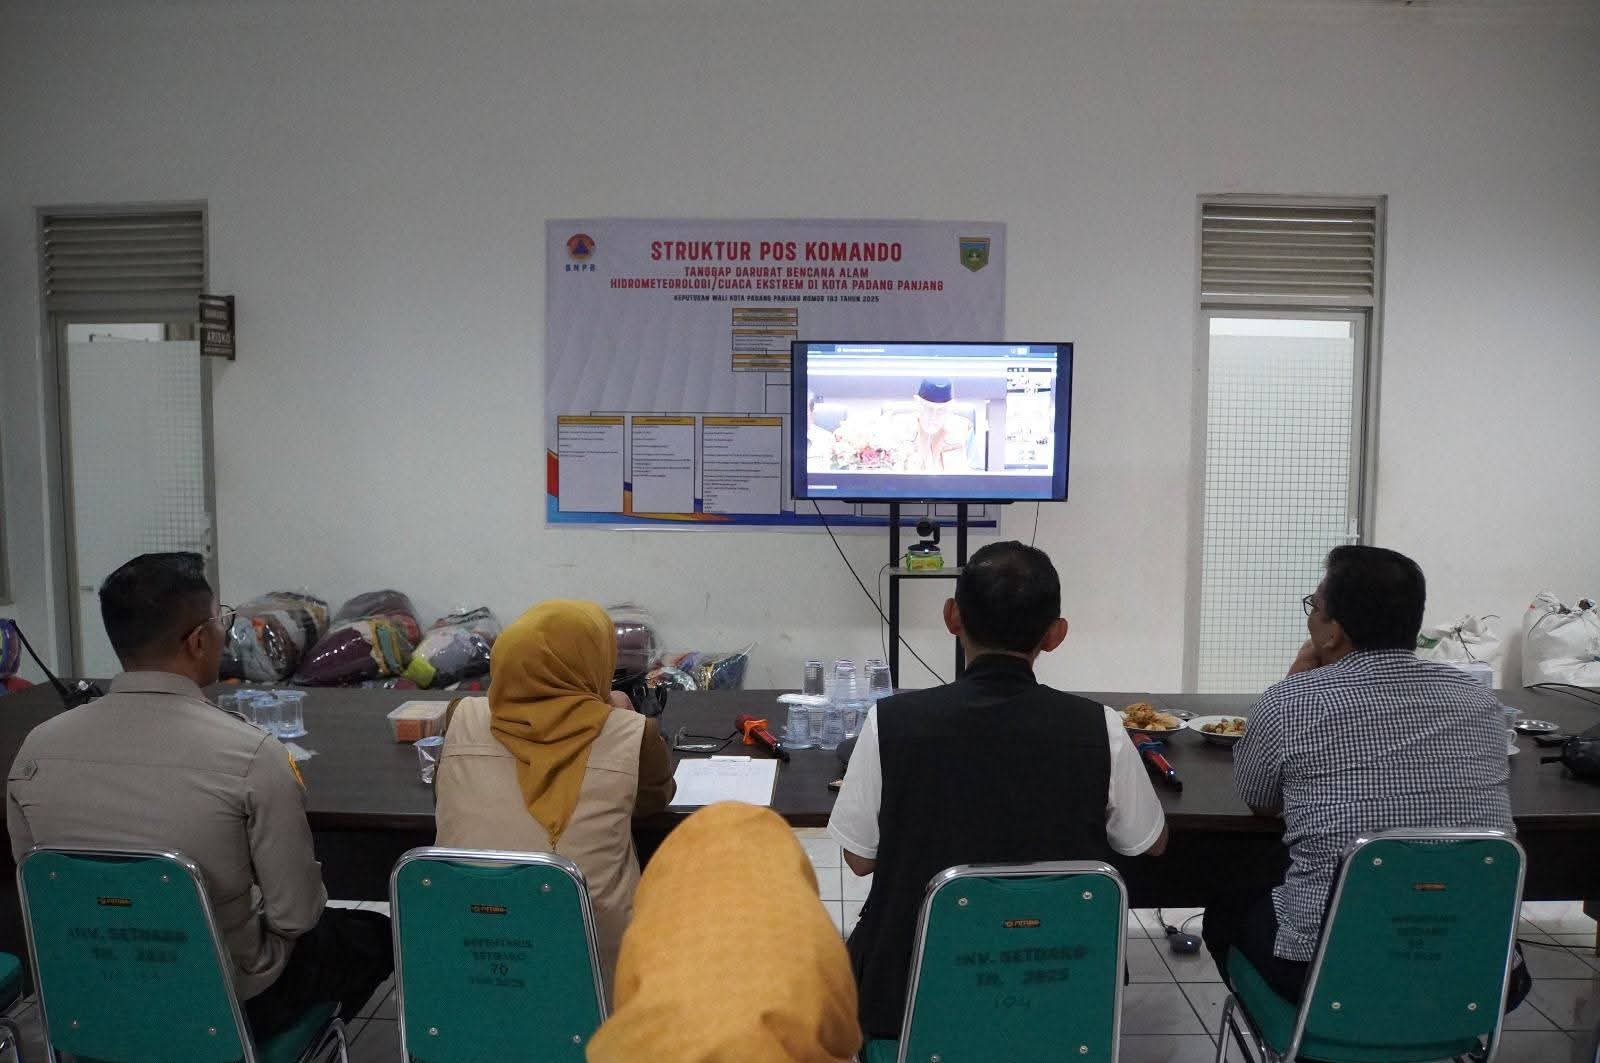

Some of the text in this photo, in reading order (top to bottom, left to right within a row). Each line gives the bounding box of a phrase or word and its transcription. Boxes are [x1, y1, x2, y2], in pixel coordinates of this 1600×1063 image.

[651, 241, 902, 262] STRUKTUR POS KOMANDO
[565, 263, 596, 272] BNPB
[685, 266, 869, 279] TANGGAP DARURAT BENCANA ALAM
[610, 277, 944, 291] HIDROMETEOROLOGI/CUACA EKSTREM DI KOTA PADANG PANJANG
[673, 294, 710, 302] KEPUTUSAN
[712, 294, 728, 302] WALI
[729, 294, 745, 302] KOTA
[746, 294, 771, 302] PADANG
[773, 294, 800, 302] PANJANG
